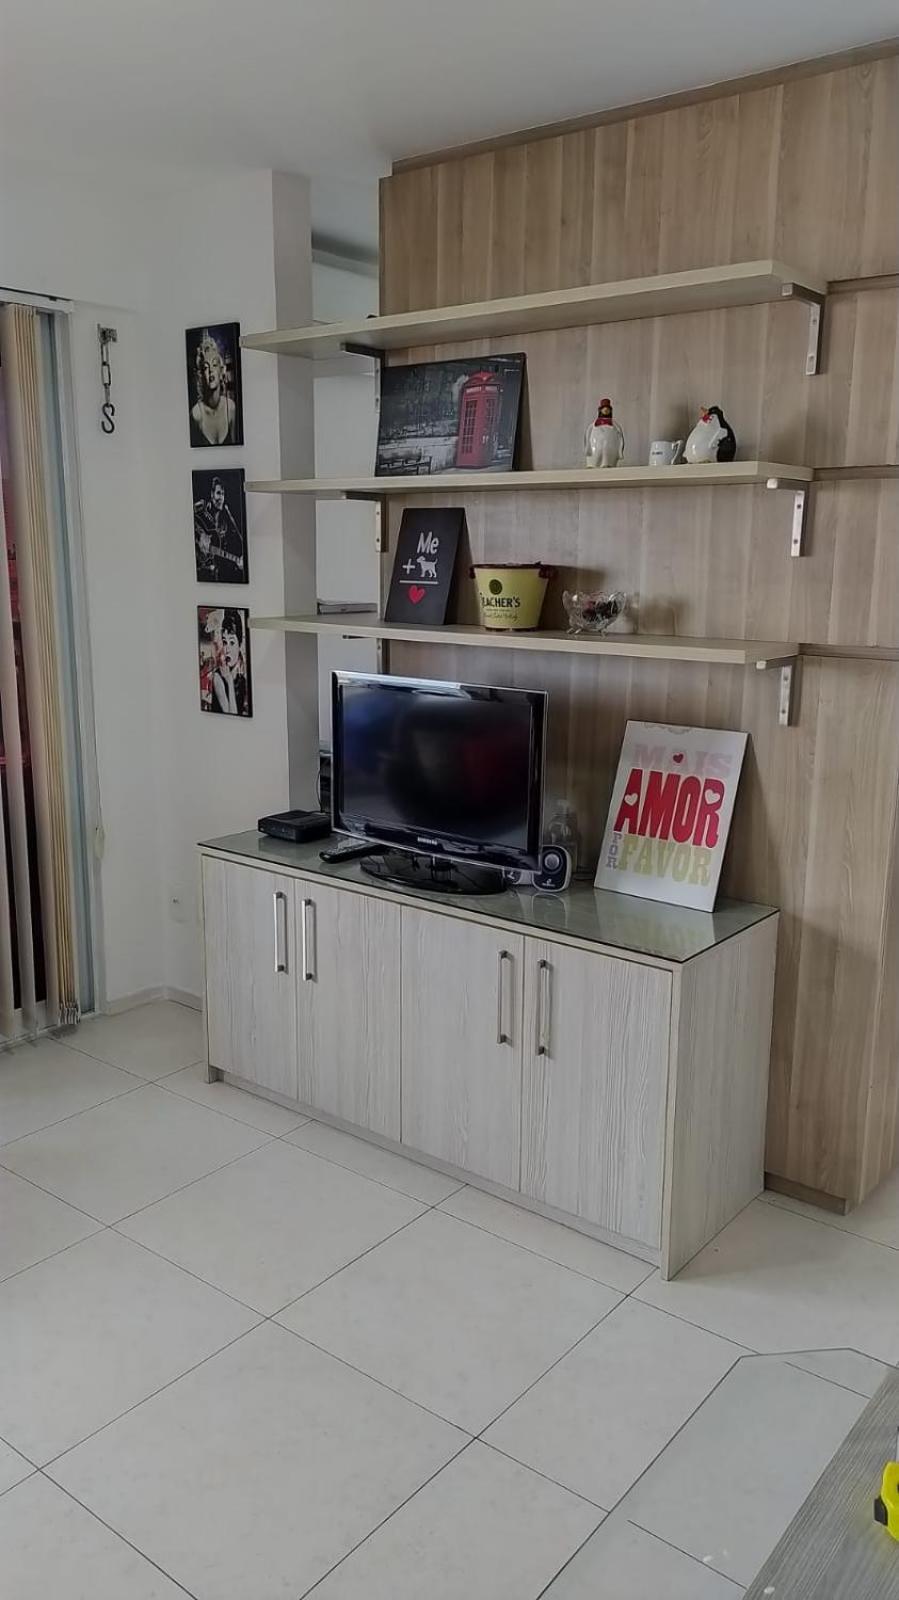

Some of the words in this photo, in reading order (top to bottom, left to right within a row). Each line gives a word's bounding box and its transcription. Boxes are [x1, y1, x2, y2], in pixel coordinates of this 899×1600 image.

[417, 532, 439, 554] Me
[633, 744, 733, 775] MAIS
[613, 768, 725, 848] AMOR
[618, 834, 711, 886] FAVOR
